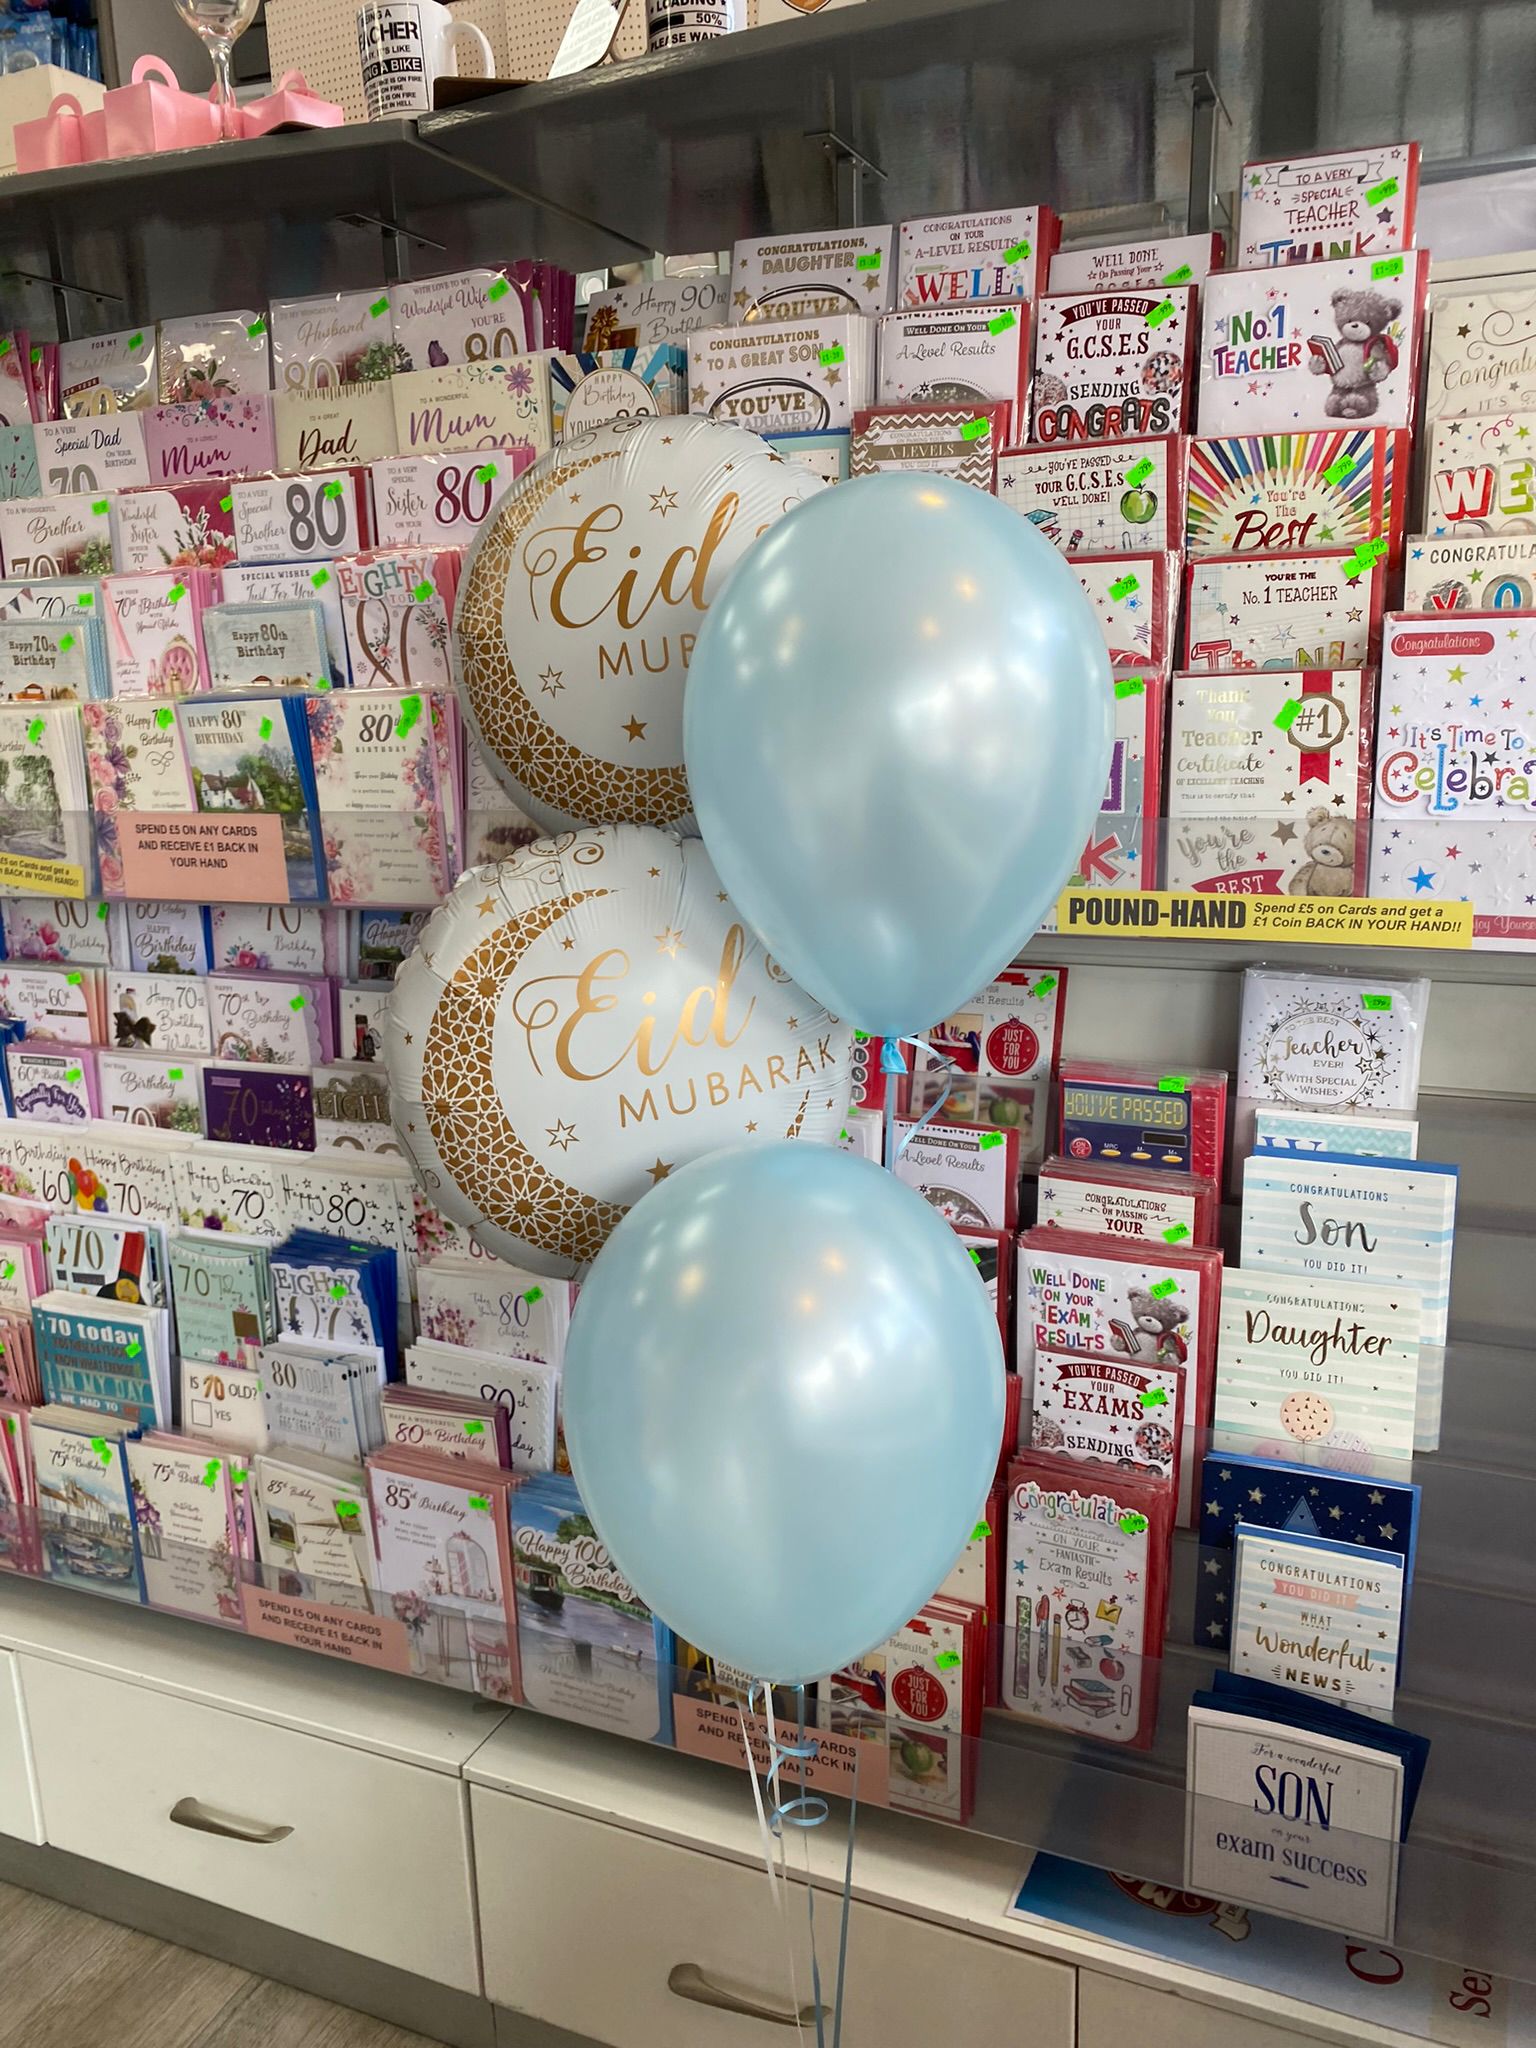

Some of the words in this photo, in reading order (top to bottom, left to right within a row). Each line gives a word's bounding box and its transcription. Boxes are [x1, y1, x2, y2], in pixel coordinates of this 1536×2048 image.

[696, 13, 722, 25] 50%
[392, 45, 411, 54] LIKE
[1296, 173, 1310, 185] TO
[1314, 173, 1322, 183] A
[1325, 168, 1353, 181] VERY
[1302, 187, 1343, 202] SPECIAL
[924, 215, 1012, 233] CONGRATULATIONS
[1284, 200, 1360, 226] TEACHER
[950, 232, 961, 241] ON
[965, 230, 984, 240] YOUR
[914, 244, 964, 260] A-LEVEL
[967, 238, 1020, 254] RESULTS
[1092, 250, 1124, 269] WELL
[1129, 248, 1159, 263] DONE
[762, 252, 855, 275] DAUGHTER
[915, 267, 1015, 304] WELL
[1071, 299, 1109, 321] YOU'VE
[1111, 299, 1149, 315] PASSED
[297, 312, 367, 346] Husband
[1096, 319, 1121, 331] YOUR
[709, 330, 820, 351] CONGRATULATIONS
[707, 359, 724, 371] TO
[727, 356, 737, 369] A
[741, 350, 785, 367] GREAT
[788, 343, 825, 362] SON
[1213, 343, 1302, 378] TEACHER
[594, 373, 624, 385] HAPPY
[1070, 380, 1140, 401] SENDING
[726, 392, 806, 417] YOU'VE
[410, 408, 495, 447] Mum
[1038, 397, 1171, 442] CONGRATS
[54, 436, 90, 456] Special
[94, 428, 122, 450] Dad
[299, 418, 357, 466] Dad
[161, 447, 231, 478] Mum
[386, 486, 428, 518] Sister
[435, 465, 492, 524] 80
[1053, 493, 1079, 507] WELL
[1082, 492, 1111, 504] DONE!
[1266, 489, 1306, 503] You're
[286, 482, 347, 551] 80
[1275, 505, 1297, 517] The
[27, 515, 86, 545] Brother
[1232, 509, 1319, 551] Best
[523, 492, 740, 629] Eid
[241, 572, 276, 582] SPECIAL
[278, 570, 311, 579] WISHES
[1265, 573, 1296, 582] YOU'RE
[1298, 571, 1317, 580] THE
[1394, 634, 1481, 655] Congratulations
[1295, 704, 1333, 739] #1
[194, 732, 245, 745] BIRTHDAY
[1181, 727, 1263, 748] Teacher
[1410, 725, 1442, 749] It's
[1448, 723, 1497, 752] Time
[1501, 728, 1524, 751] To
[1176, 753, 1265, 773] Certificate
[135, 824, 167, 835] SPEND
[169, 825, 181, 835] £5
[183, 826, 197, 836] ON
[199, 826, 219, 836] ANY
[222, 826, 258, 837] CARDS
[138, 840, 158, 851] AND
[161, 841, 201, 852] RECEIVE
[203, 843, 215, 853] £1
[217, 843, 247, 853] BACK
[248, 843, 258, 853] IN
[170, 857, 198, 868] YOUR
[200, 858, 228, 869] HAND
[1216, 874, 1264, 895] BEST
[1070, 898, 1246, 929] POUND-HAND
[1254, 903, 1296, 915] Spend
[1299, 903, 1314, 914] £5
[1317, 905, 1335, 914] on
[1337, 903, 1377, 915] Cards
[1380, 905, 1406, 916] and
[1410, 907, 1432, 919] get
[1434, 908, 1444, 916] a
[1253, 917, 1269, 928] £1
[1273, 917, 1302, 928] Coin
[1306, 918, 1345, 929] BACK
[1349, 918, 1364, 929] IN
[1367, 919, 1411, 930] YOUR
[1413, 920, 1462, 932] HAND!!
[135, 933, 197, 962] Birthday
[513, 924, 756, 1081] Eid
[242, 1009, 290, 1032] Birthday
[1002, 1028, 1024, 1043] JUST
[1003, 1042, 1021, 1057] FOR
[1002, 1056, 1020, 1070] YOU
[120, 1069, 176, 1099] Birthday
[620, 1034, 836, 1128] MUBARAK
[1065, 1093, 1118, 1119] YOU'VE
[1122, 1097, 1184, 1126] PASSED
[42, 1170, 72, 1205] 60
[1290, 1183, 1389, 1203] CONGRATULATIONS
[232, 1189, 265, 1220] 70
[1105, 1217, 1144, 1236] YOUR
[1294, 1200, 1378, 1254] Son
[1303, 1258, 1322, 1271] YOU
[1327, 1261, 1345, 1273] DID
[1351, 1264, 1368, 1275] IT!
[177, 1264, 210, 1298] 70
[1033, 1268, 1066, 1288] WELL
[1072, 1271, 1106, 1293] DONE
[1044, 1289, 1061, 1302] ON
[1065, 1291, 1094, 1307] YOUR
[1266, 1293, 1366, 1314] CONGRATULATIONS
[500, 1291, 530, 1330] 80
[1046, 1305, 1091, 1329] EXAM
[47, 1316, 71, 1337] 70
[76, 1321, 139, 1346] today
[1035, 1323, 1105, 1350] RESULTS
[1245, 1309, 1393, 1367] Daughter
[190, 1375, 199, 1390] IS
[228, 1383, 257, 1401] OLD?
[1090, 1380, 1115, 1394] YOUR
[214, 1409, 232, 1422] YES
[1063, 1389, 1145, 1421] EXAMS
[433, 1427, 487, 1450] Birthday
[1066, 1436, 1135, 1458] SENDING
[1053, 1533, 1068, 1545] ON
[1073, 1536, 1100, 1551] YOUR
[1055, 1550, 1095, 1565] FANTASTIC
[565, 1560, 636, 1601] Birthday
[1039, 1558, 1072, 1577] Exam
[1075, 1566, 1112, 1587] Results
[1260, 1559, 1381, 1594] CONGRATULATIONS
[258, 1598, 291, 1615] SPEND
[306, 1611, 321, 1622] ON
[323, 1615, 343, 1627] ANY
[346, 1619, 382, 1637] CARDS
[1300, 1611, 1332, 1627] WHAT
[294, 1634, 321, 1649] YOUR
[324, 1642, 352, 1656] HAND
[1255, 1626, 1374, 1673] Wonderful
[908, 1674, 930, 1693] JUST
[1286, 1667, 1342, 1692] NEWS
[911, 1689, 928, 1705] FOR
[910, 1701, 929, 1718] YOU
[698, 1724, 725, 1740] AND
[842, 1759, 856, 1774] IN
[1254, 1764, 1334, 1832] SON
[1216, 1832, 1275, 1862] exam
[1282, 1850, 1368, 1888] success
